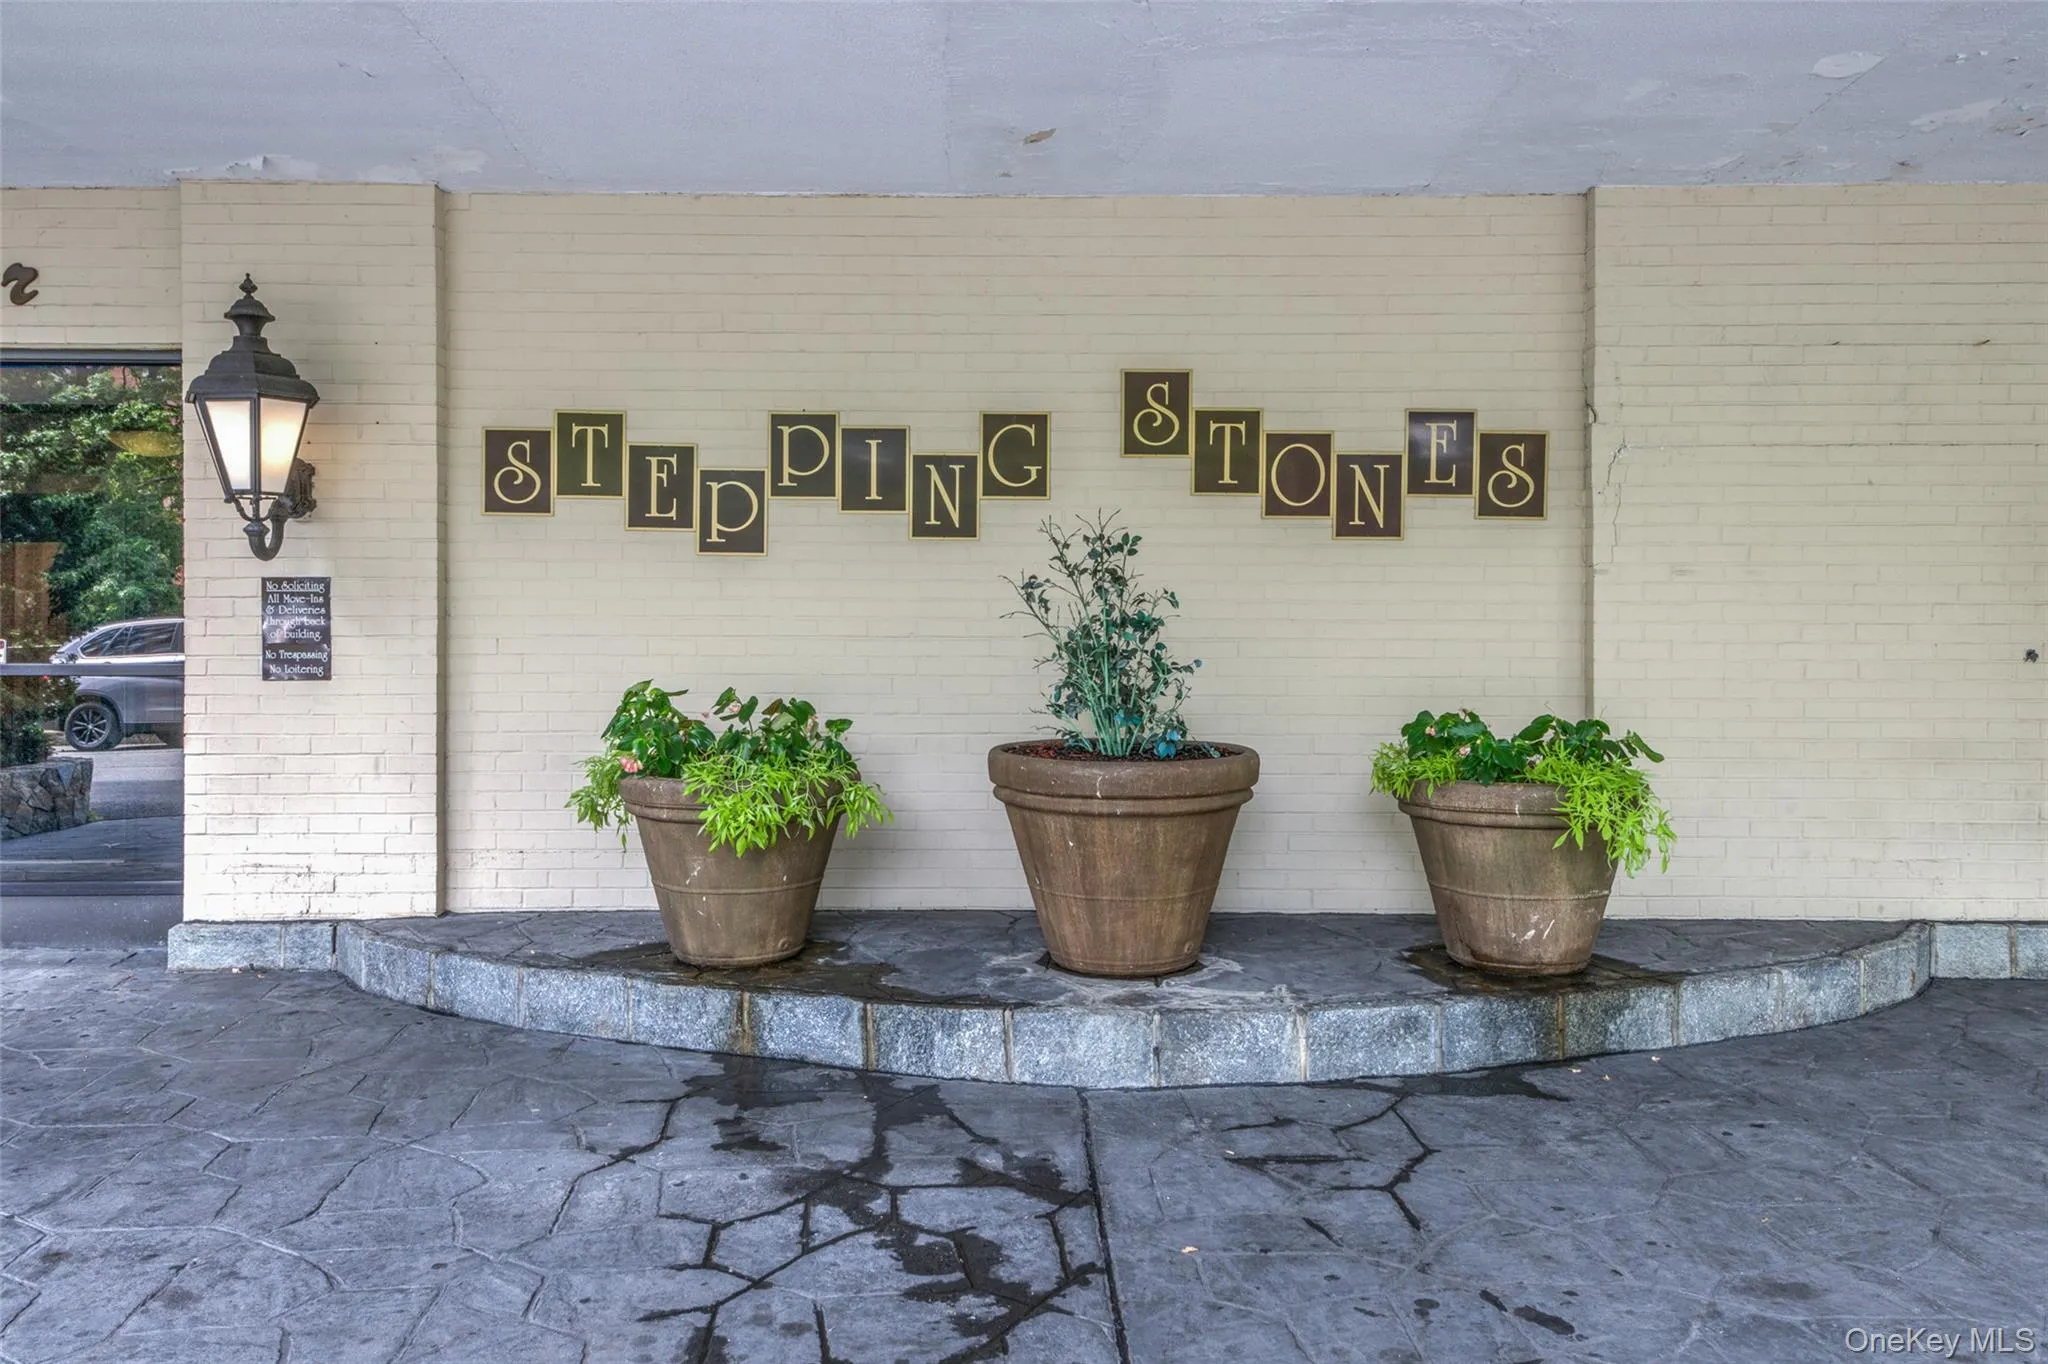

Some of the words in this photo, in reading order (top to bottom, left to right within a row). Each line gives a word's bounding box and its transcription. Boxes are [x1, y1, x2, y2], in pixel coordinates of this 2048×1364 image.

[493, 422, 1043, 543] STEPPING
[1133, 381, 1536, 528] STONES
[266, 581, 279, 592] No
[281, 581, 325, 593] Soliciting
[268, 594, 280, 603] All
[283, 594, 324, 603] Move-Ins
[265, 605, 275, 615] &
[278, 605, 326, 615] Deliveries
[303, 616, 326, 626] back
[270, 629, 282, 638] of
[266, 650, 277, 659] No
[279, 650, 328, 662] Trespassing
[270, 664, 282, 673] No
[285, 664, 324, 677] Loitering
